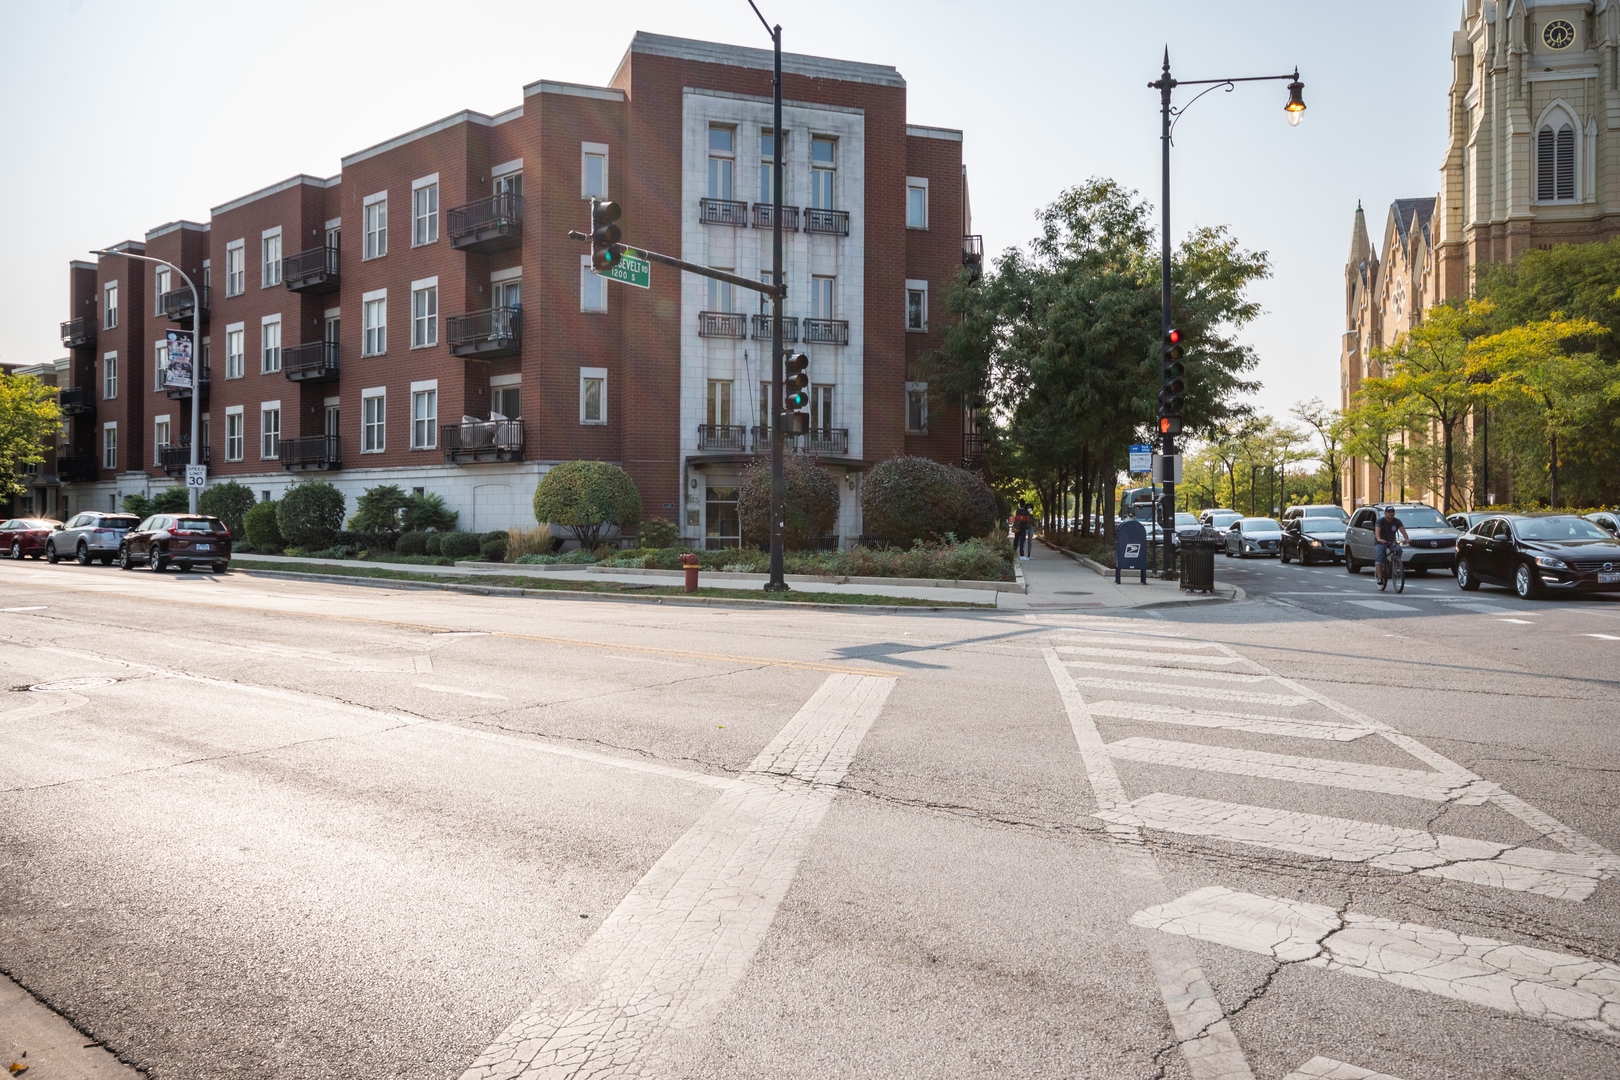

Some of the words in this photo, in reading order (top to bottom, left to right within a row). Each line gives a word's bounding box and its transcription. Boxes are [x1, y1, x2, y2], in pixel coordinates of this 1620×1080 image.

[641, 265, 649, 274] RD
[611, 268, 628, 280] 1200
[631, 273, 636, 282] S
[188, 476, 204, 486] 30
